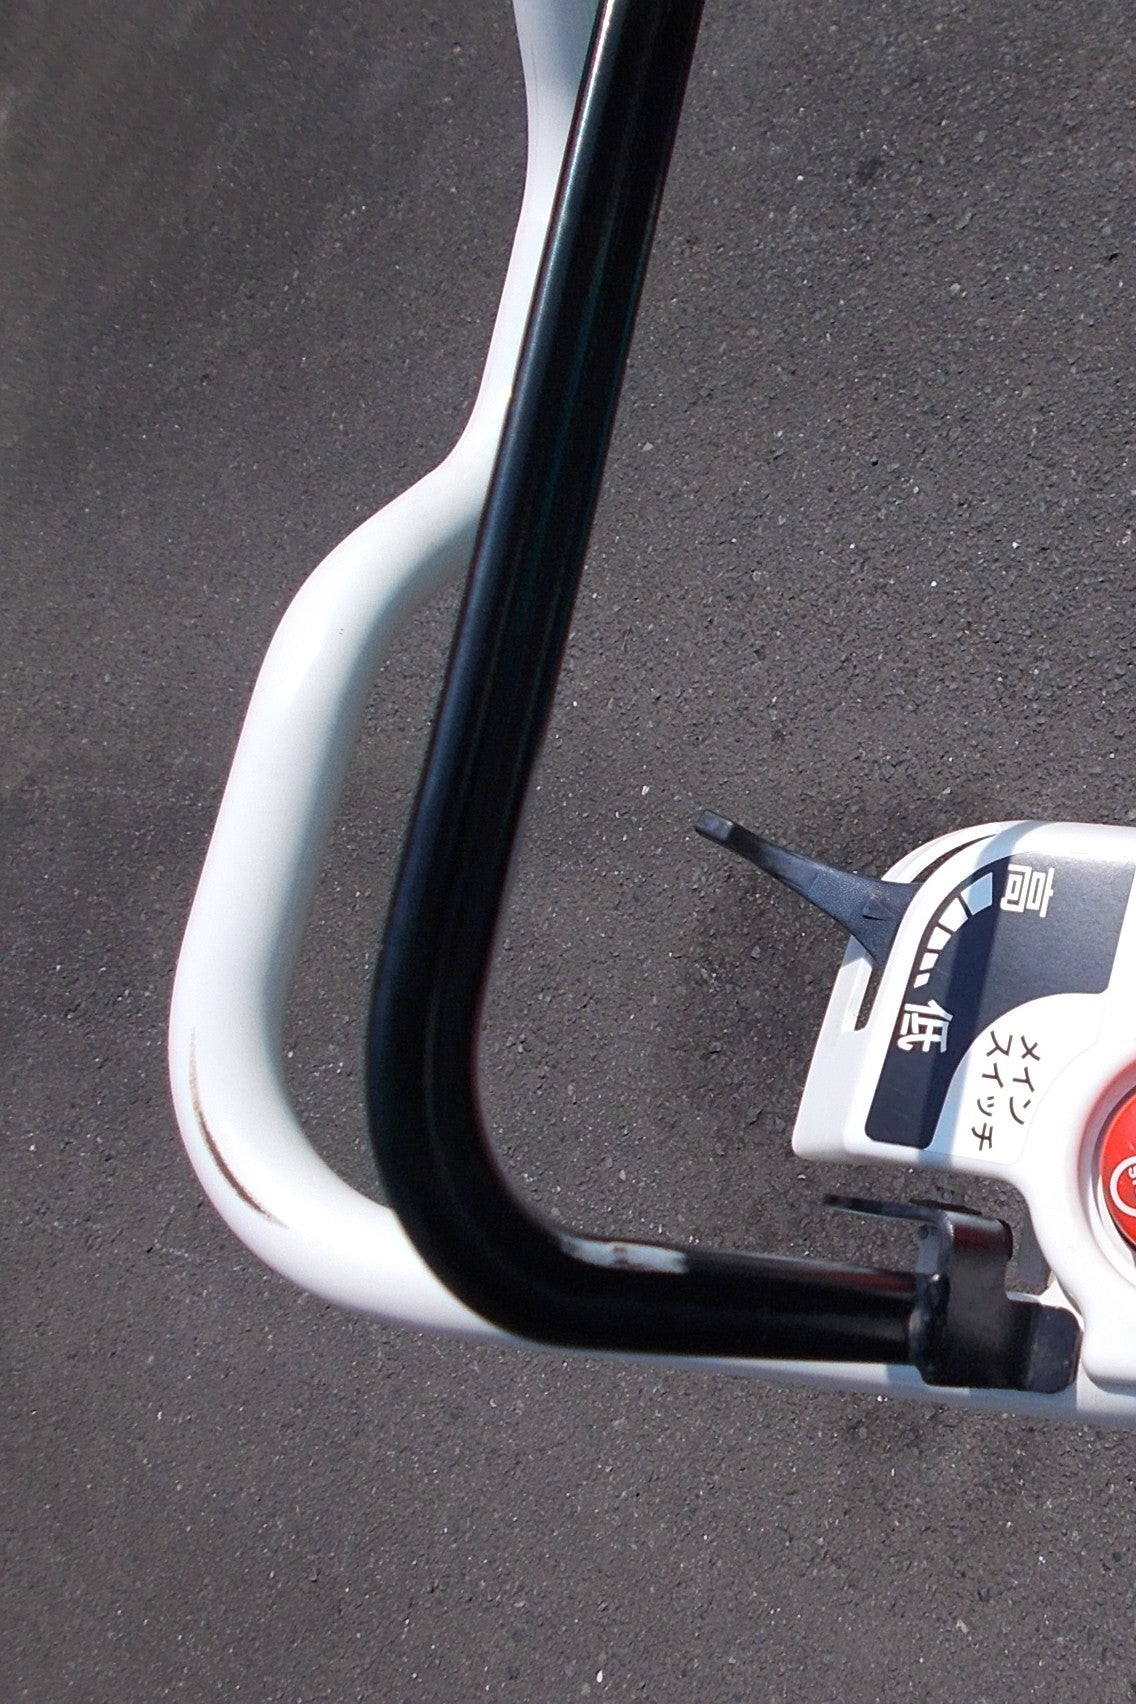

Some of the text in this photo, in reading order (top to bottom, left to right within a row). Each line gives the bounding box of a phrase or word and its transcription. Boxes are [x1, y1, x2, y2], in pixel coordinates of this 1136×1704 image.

[1000, 864, 1056, 918] 高
[896, 999, 954, 1054] 低
[970, 1030, 1013, 1152] スイッチ
[1008, 1034, 1041, 1126] メイン
